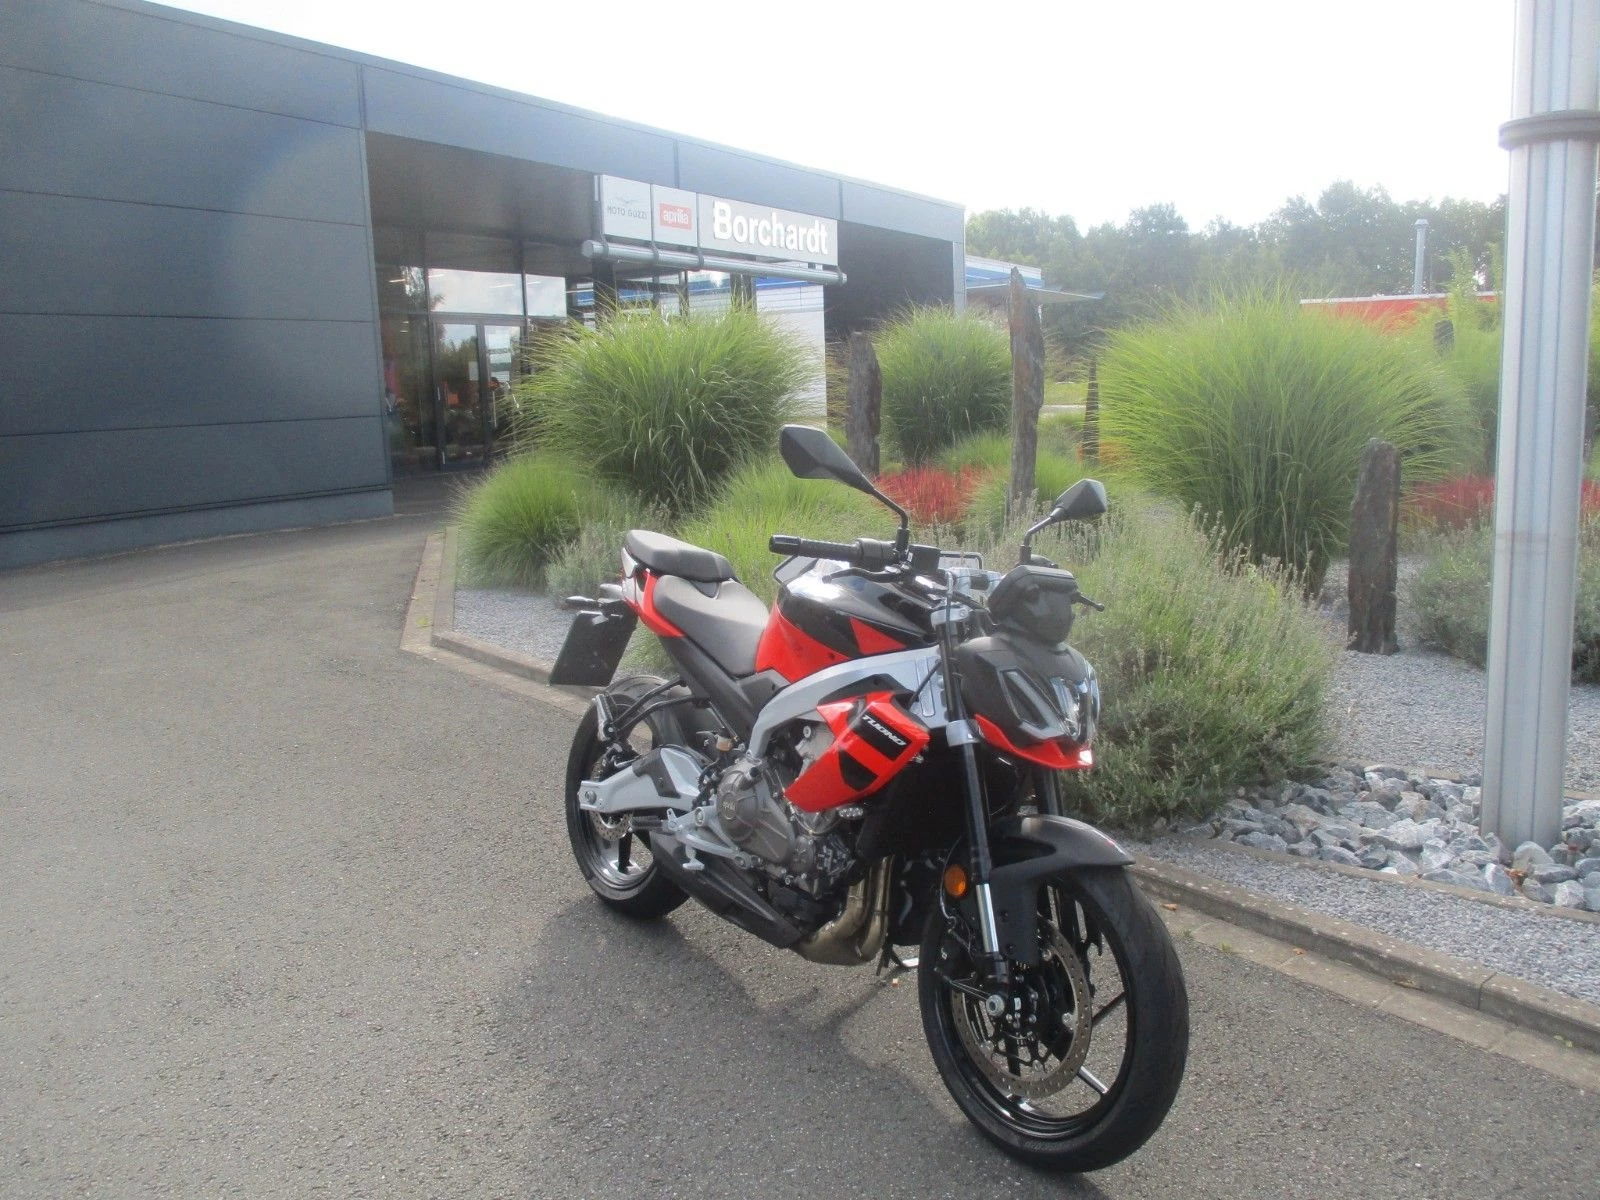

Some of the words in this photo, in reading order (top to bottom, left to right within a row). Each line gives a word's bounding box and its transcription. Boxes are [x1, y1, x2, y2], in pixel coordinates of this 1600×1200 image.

[607, 206, 626, 217] MOTO
[627, 209, 648, 220] GUZZI
[663, 209, 689, 225] aprilia
[713, 200, 828, 255] Borchardt
[862, 714, 907, 746] TUONO
